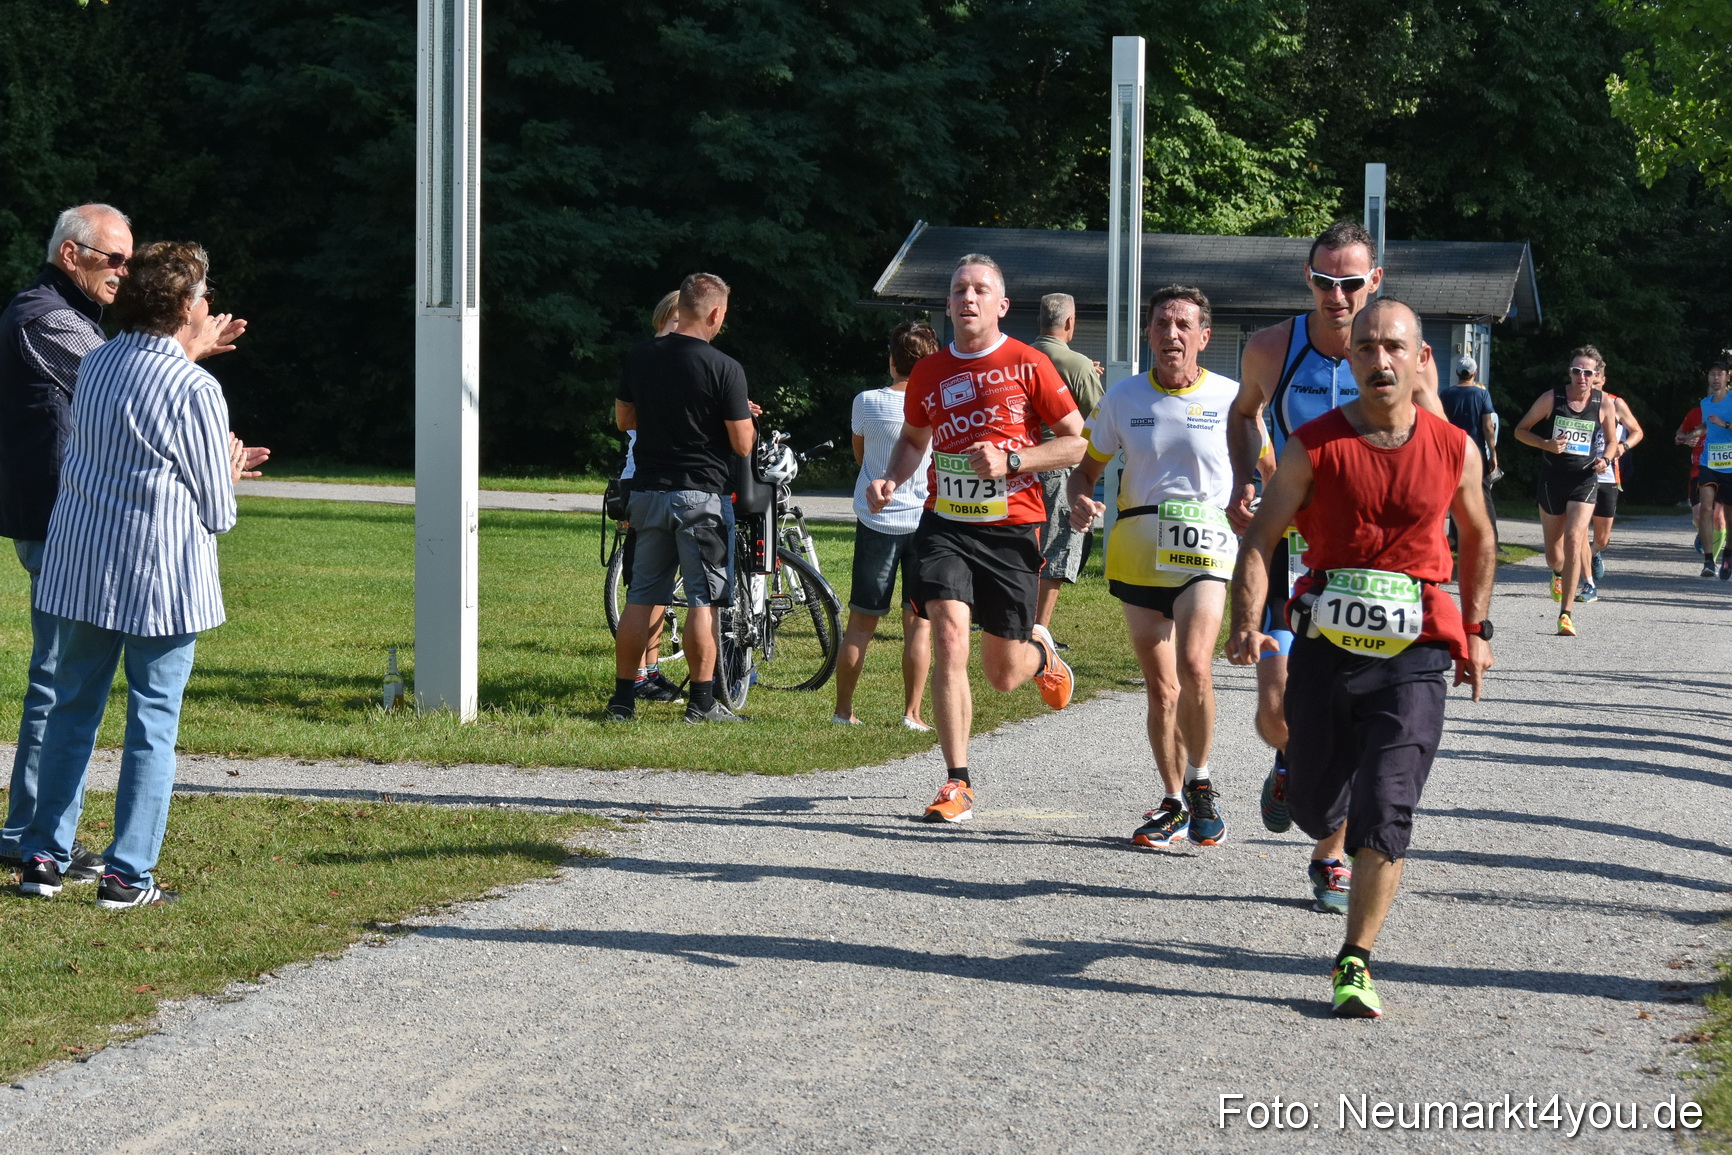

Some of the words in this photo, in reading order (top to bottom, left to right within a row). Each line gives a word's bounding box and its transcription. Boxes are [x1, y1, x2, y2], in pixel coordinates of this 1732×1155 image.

[942, 374, 970, 389] raumbox
[981, 384, 1020, 397] schenken
[1188, 406, 1202, 416] 20
[1187, 423, 1214, 431] Stadtlauf
[1558, 420, 1590, 430] BOCK
[1557, 429, 1588, 443] 2005
[943, 477, 997, 499] 1173
[949, 503, 989, 514] TOBIAS
[1166, 502, 1228, 524] BOCK
[1168, 525, 1228, 554] 1052
[1169, 553, 1225, 569] HERBERT
[1330, 573, 1409, 597] BOCK
[1327, 598, 1405, 633] 1091
[1341, 635, 1386, 650] EYUP
